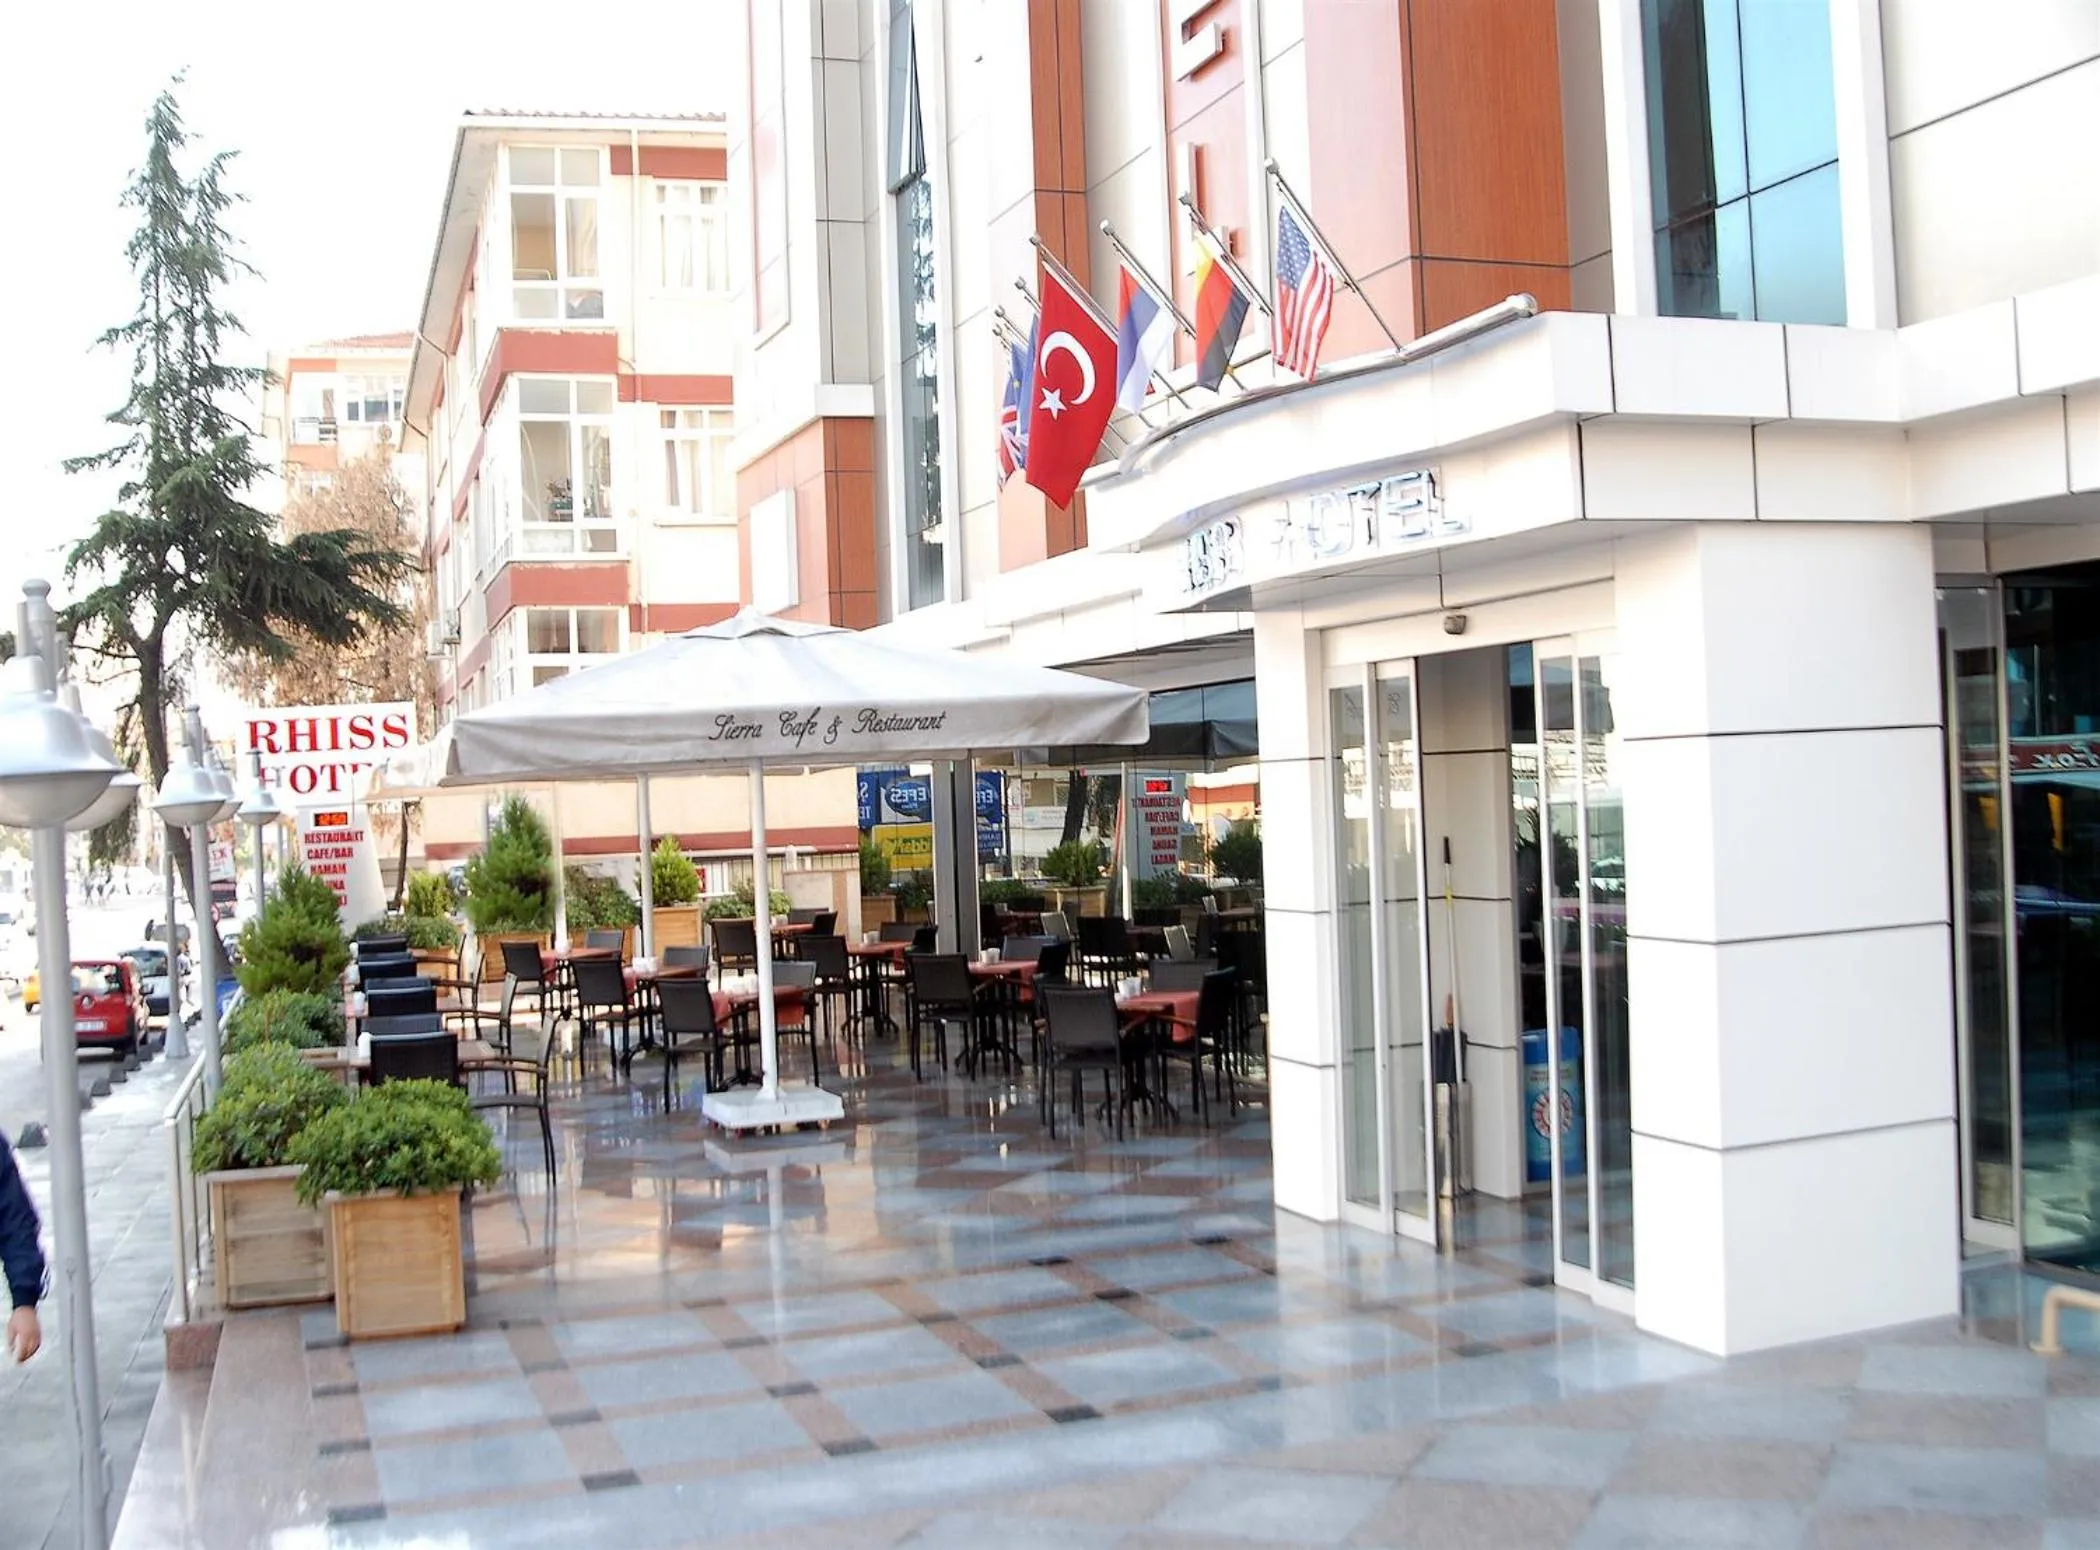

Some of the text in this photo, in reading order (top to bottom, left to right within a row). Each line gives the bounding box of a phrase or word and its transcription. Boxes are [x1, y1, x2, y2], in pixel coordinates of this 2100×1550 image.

[246, 714, 409, 755] RHISS
[708, 705, 947, 749] Sierra Cafe & Restaurant
[307, 847, 354, 860] CAFE/BAR
[310, 863, 347, 876] HAMAM
